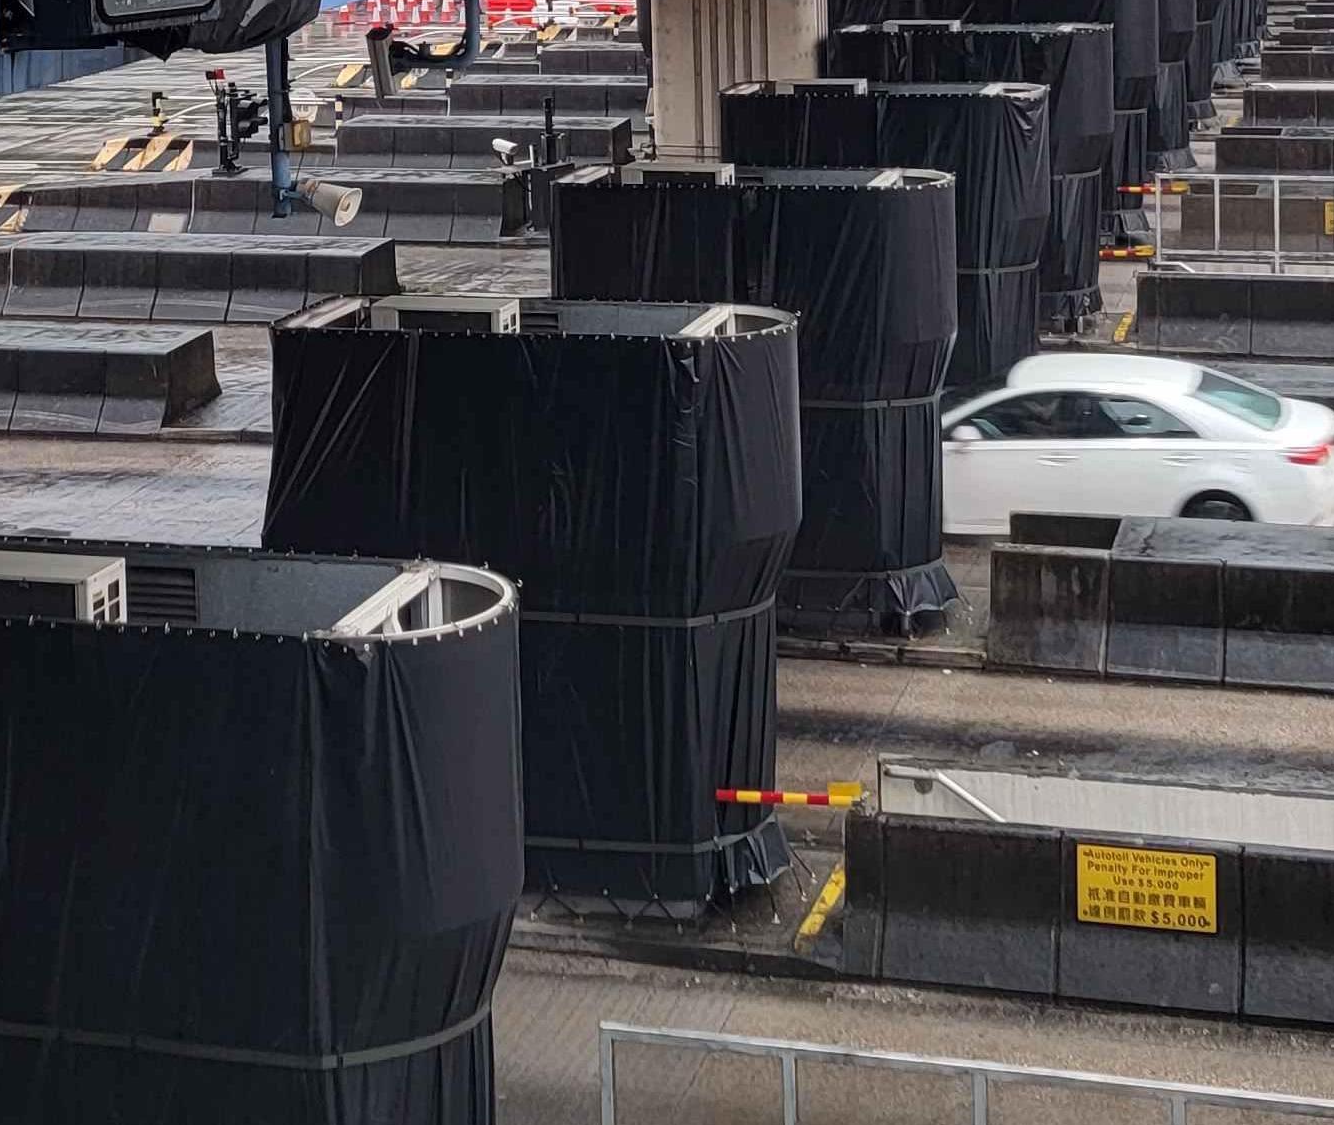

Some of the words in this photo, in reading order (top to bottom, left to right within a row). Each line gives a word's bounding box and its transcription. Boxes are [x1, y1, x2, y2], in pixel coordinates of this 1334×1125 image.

[1088, 849, 1129, 862] Autotoll
[1132, 851, 1177, 867] Vehicles
[1180, 856, 1205, 870] Only
[1087, 860, 1128, 875] Penalty
[1131, 863, 1151, 876] For
[1153, 866, 1204, 882] Improper
[1113, 875, 1135, 886] Use
